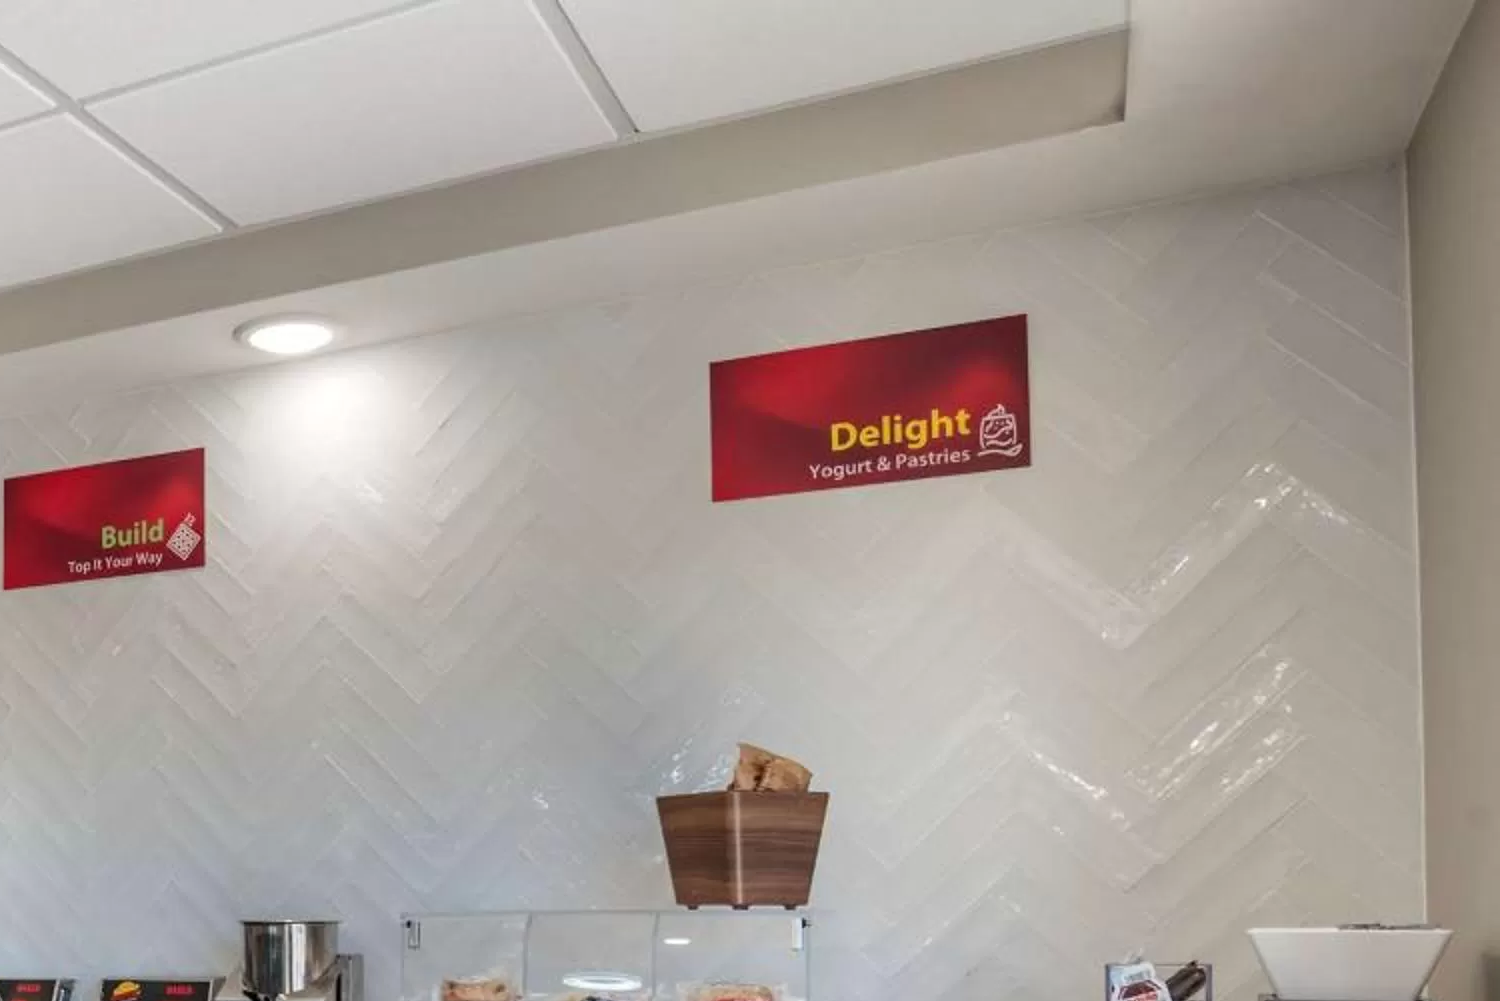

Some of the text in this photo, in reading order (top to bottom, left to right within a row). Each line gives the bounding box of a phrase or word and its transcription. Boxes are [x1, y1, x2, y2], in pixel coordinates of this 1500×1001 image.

[830, 408, 972, 452] Delight
[809, 448, 971, 481] Yogurt & Pastries
[101, 518, 165, 549] Build
[68, 552, 163, 575] Top It Your Way
